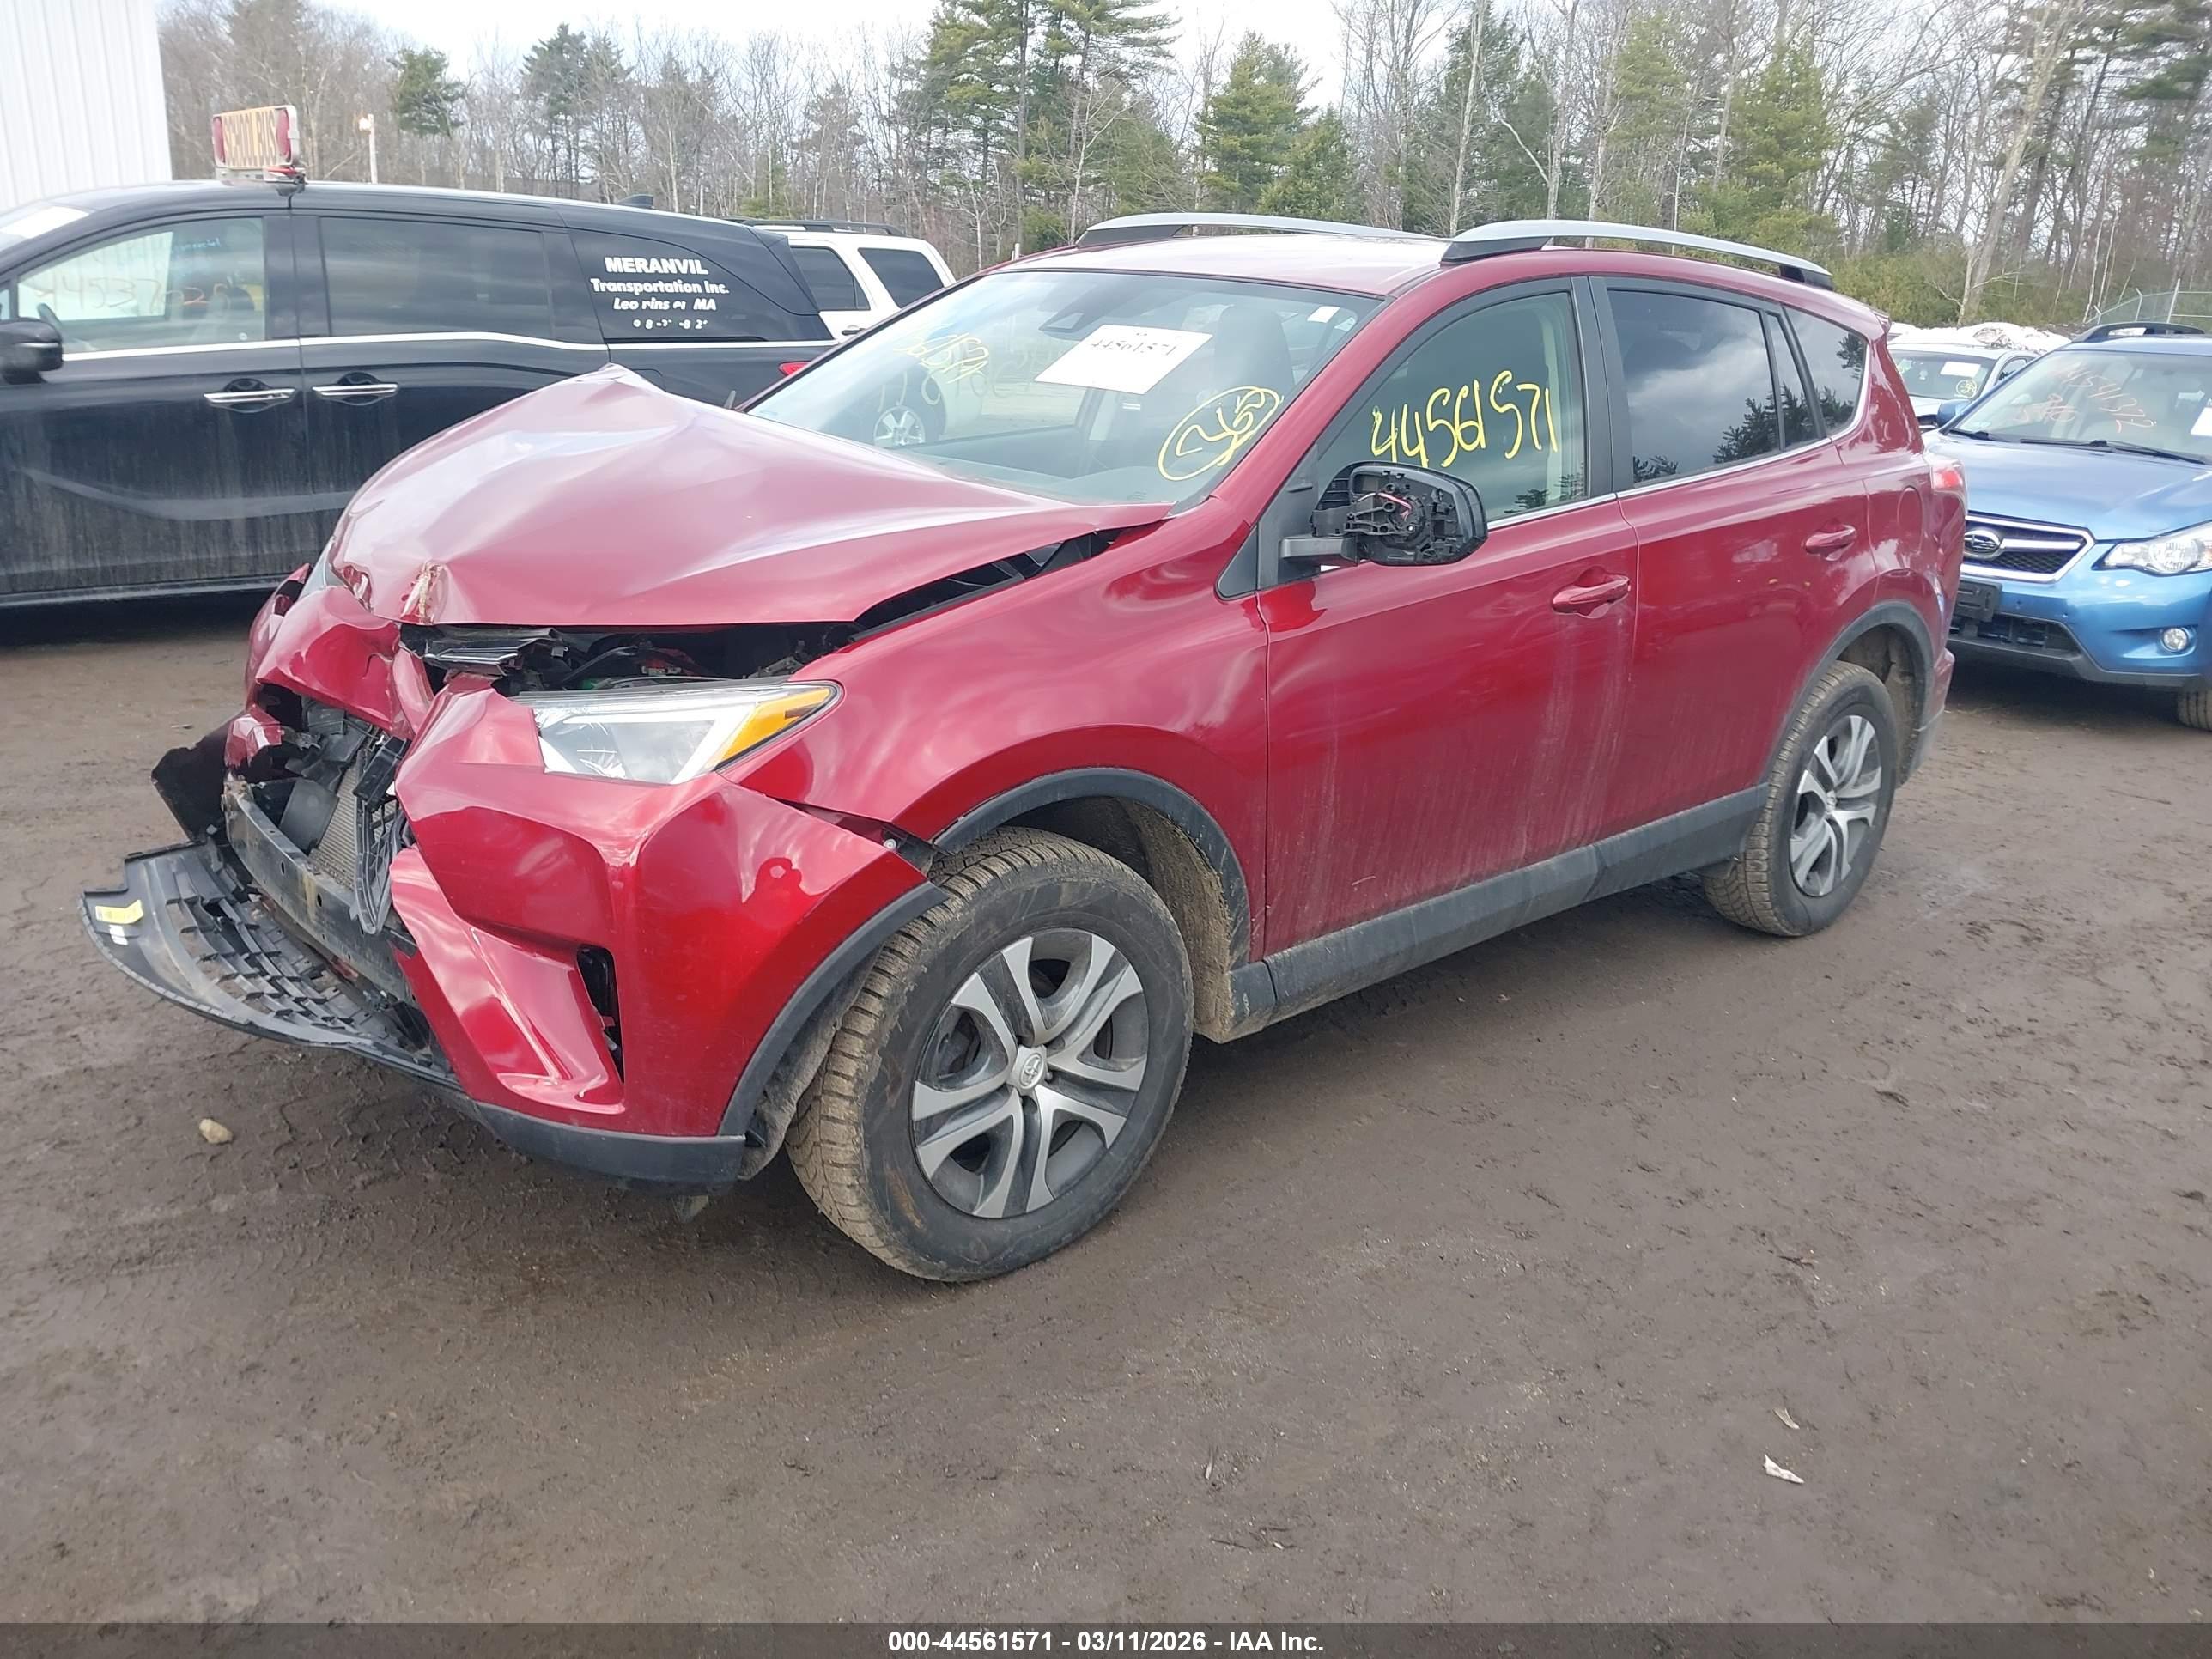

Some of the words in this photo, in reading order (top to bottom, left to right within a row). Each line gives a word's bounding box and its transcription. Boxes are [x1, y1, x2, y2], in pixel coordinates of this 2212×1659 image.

[257, 110, 276, 167] BUS
[604, 257, 708, 275] MERANVIL
[590, 277, 702, 295] Transportation
[704, 280, 730, 294] Inc.
[693, 298, 717, 310] MA
